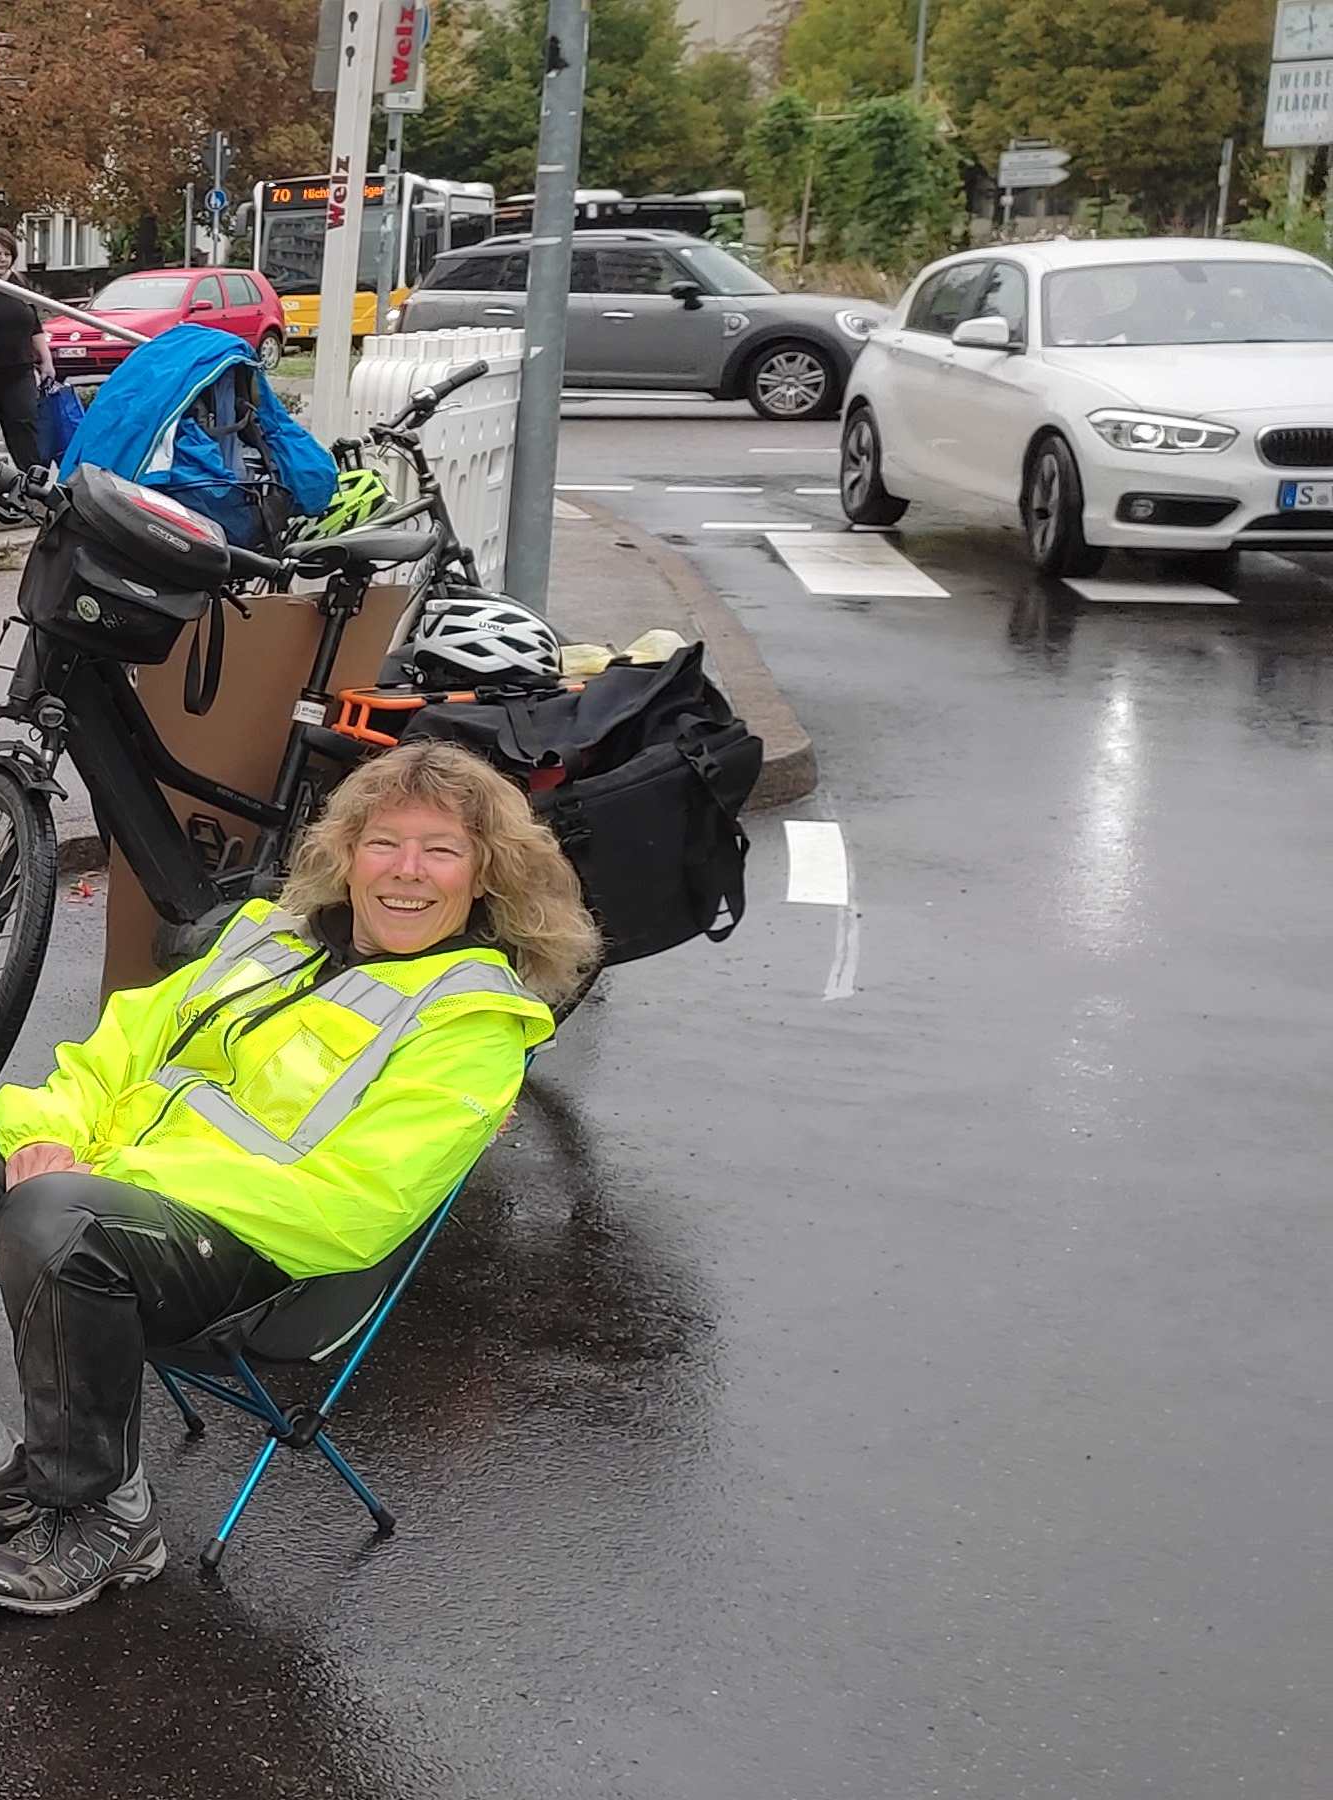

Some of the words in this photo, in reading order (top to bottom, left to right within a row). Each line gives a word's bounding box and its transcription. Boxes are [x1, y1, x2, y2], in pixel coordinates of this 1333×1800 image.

[390, 4, 415, 84] Welz
[272, 188, 291, 202] 70
[327, 155, 350, 231] Welz
[478, 621, 507, 633] uvex
